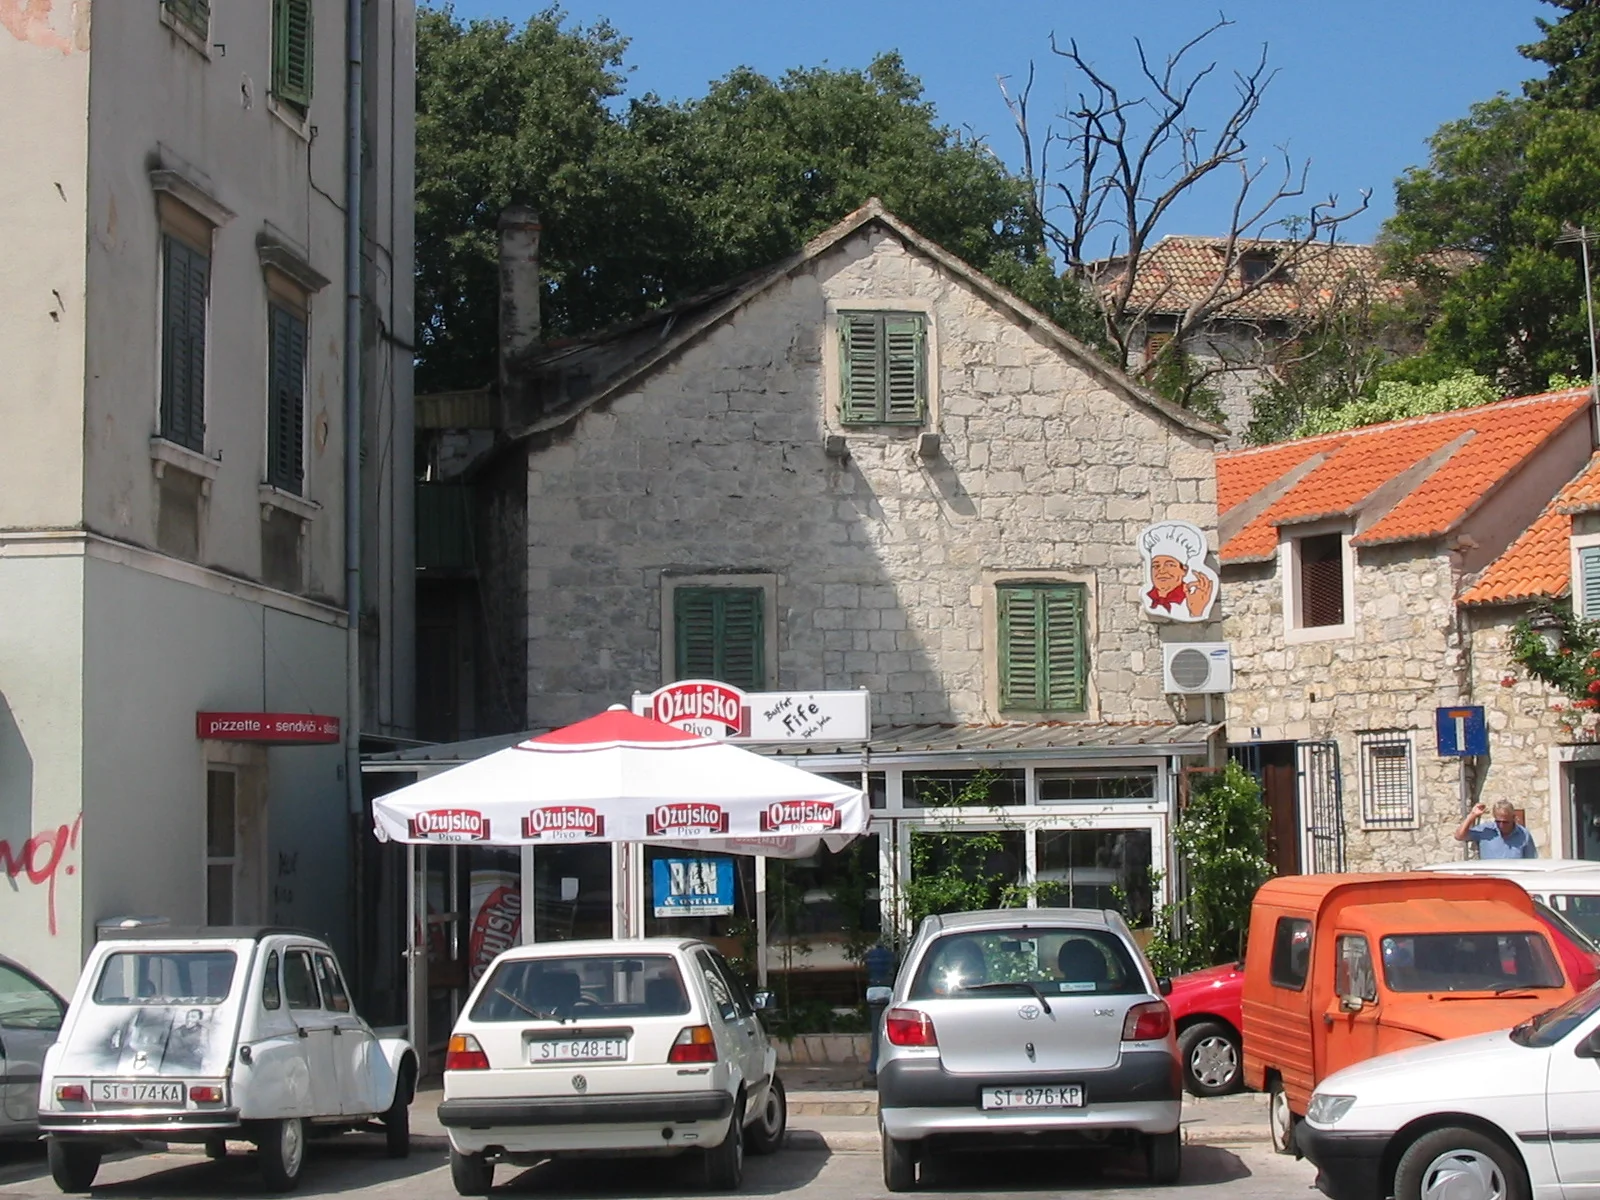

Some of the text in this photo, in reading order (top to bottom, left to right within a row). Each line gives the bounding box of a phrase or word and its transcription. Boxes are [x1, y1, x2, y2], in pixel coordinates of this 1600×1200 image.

[658, 686, 738, 724] Ožujsko
[210, 719, 260, 733] pizzette
[417, 810, 480, 833] Ožujsko
[531, 807, 594, 831] Ožujsko
[657, 804, 719, 827] Ožujsko
[771, 801, 832, 824] Ožujsko
[677, 827, 701, 836] Pivo
[669, 862, 717, 895] BAN
[541, 1041, 623, 1058] ST 648-ET
[103, 1085, 179, 1100] ST 174-KA
[995, 1090, 1012, 1106] ST
